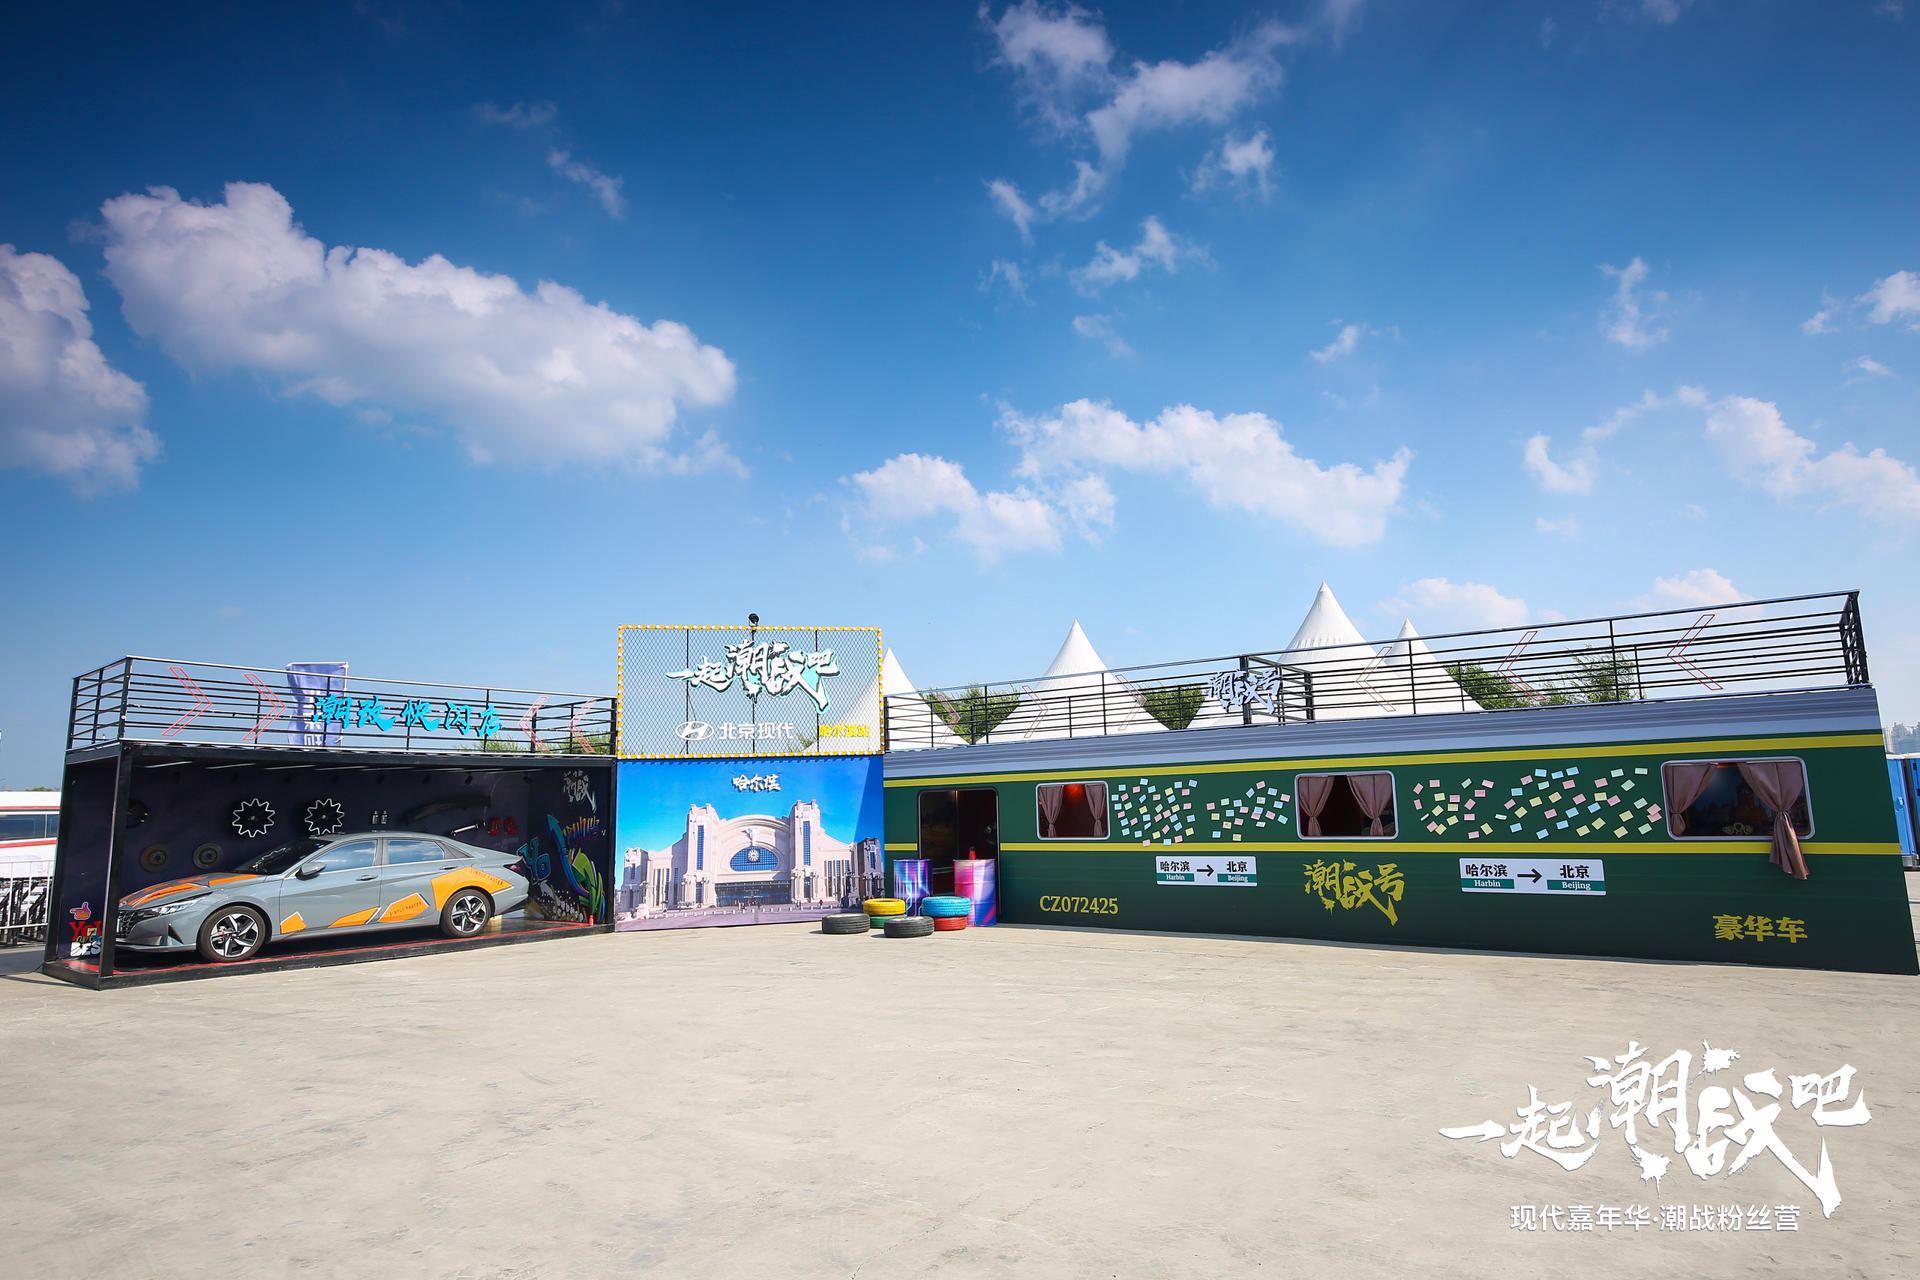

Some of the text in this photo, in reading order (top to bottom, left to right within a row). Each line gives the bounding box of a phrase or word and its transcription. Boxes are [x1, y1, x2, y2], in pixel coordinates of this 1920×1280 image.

[664, 640, 840, 713] 一起潮战吧
[1208, 668, 1281, 715] 潮战号
[313, 693, 502, 736] 潮改快闪店
[718, 722, 794, 740] 北京现代
[1160, 860, 1248, 873] 哈尔滨 北京
[1465, 864, 1590, 879] 哈尔滨 北京
[1227, 874, 1249, 882] Beijing
[1474, 879, 1591, 891] Harbin Beijing
[1302, 859, 1405, 926] 潮战号
[1039, 895, 1119, 914] CZ072425
[1712, 914, 1808, 943] 豪华车
